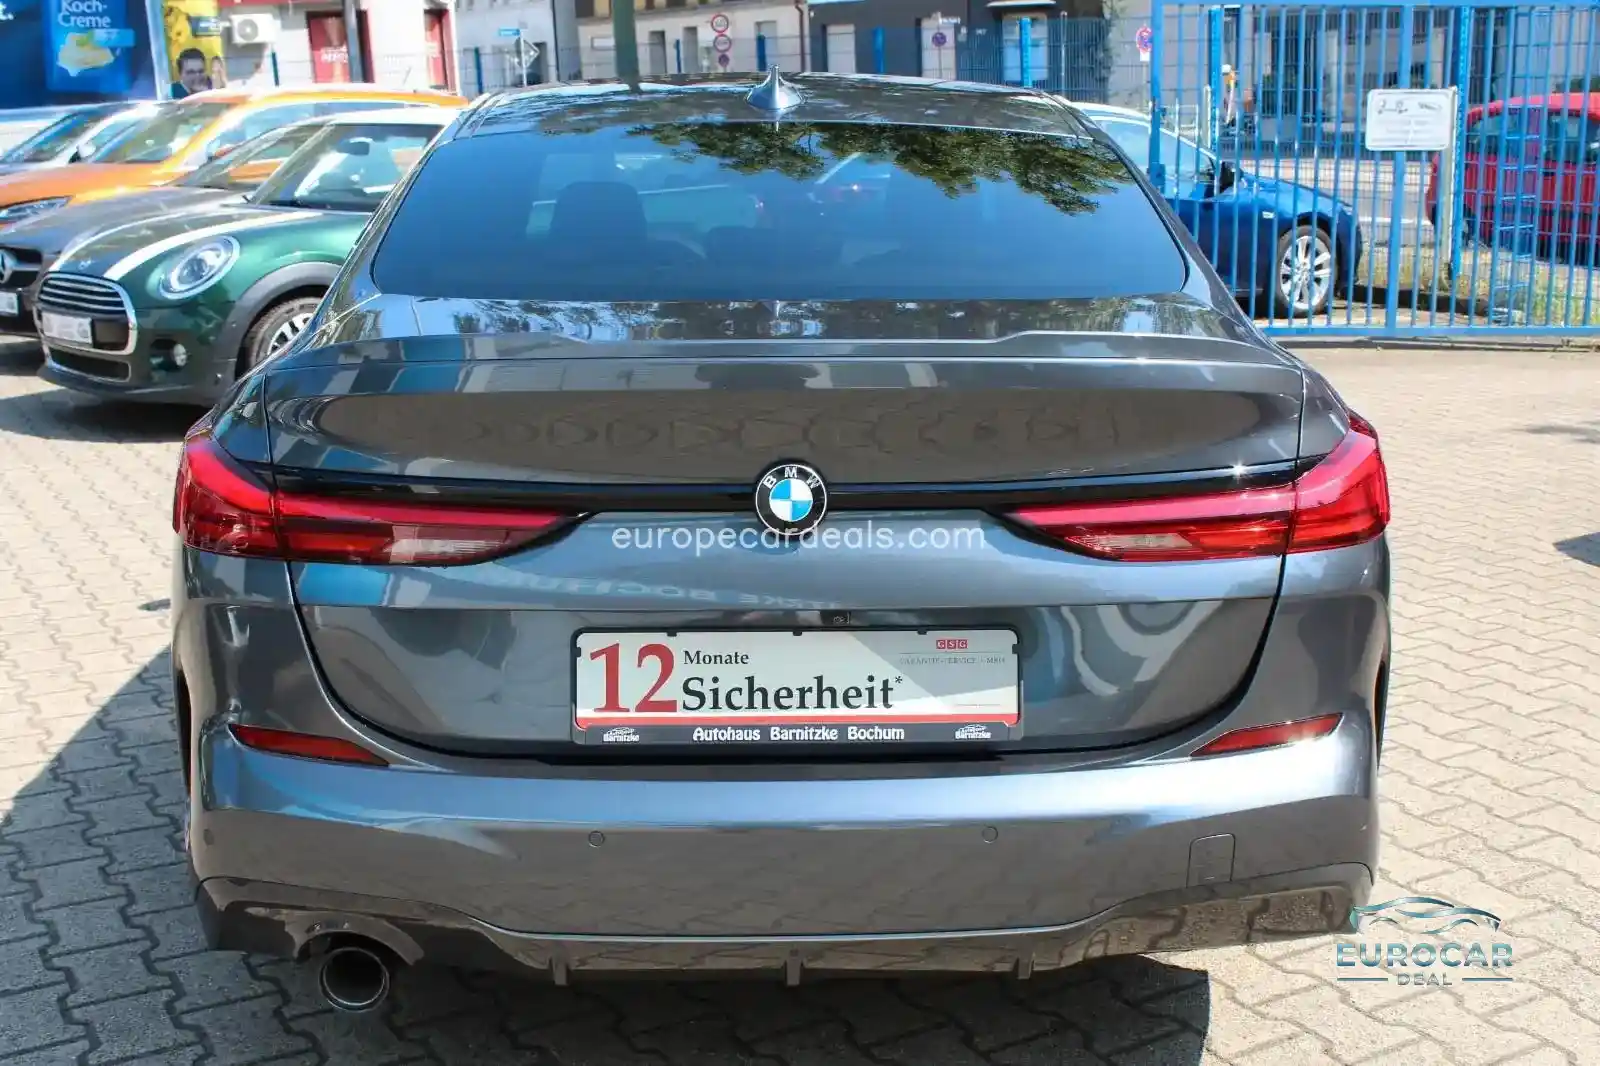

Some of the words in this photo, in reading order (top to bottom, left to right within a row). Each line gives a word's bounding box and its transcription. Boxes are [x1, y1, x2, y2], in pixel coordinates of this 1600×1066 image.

[61, 0, 108, 13] Koch-
[58, 13, 112, 28] Creme
[762, 466, 821, 490] BMW
[936, 639, 968, 650] GSG
[683, 650, 750, 665] Monate
[589, 642, 678, 713] 12
[692, 726, 761, 741] Autohaus
[770, 726, 839, 741] Barnitzke
[847, 726, 905, 741] Bochum
